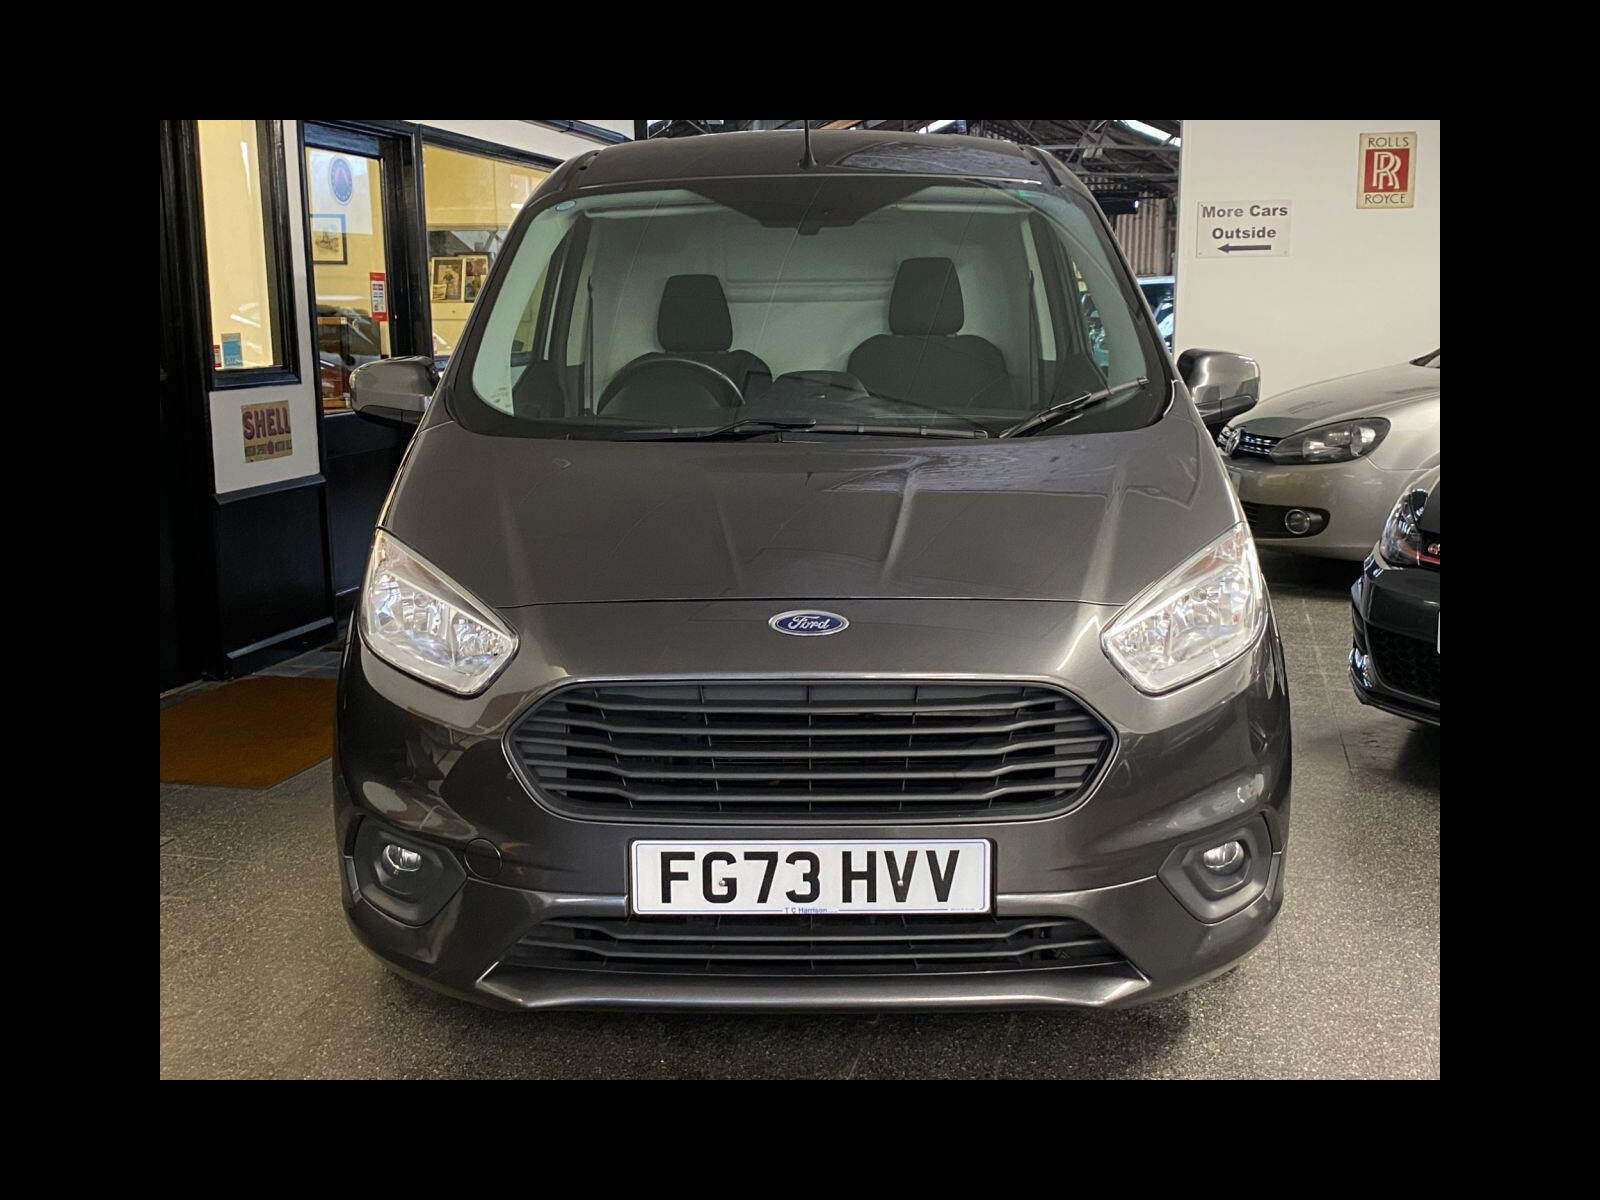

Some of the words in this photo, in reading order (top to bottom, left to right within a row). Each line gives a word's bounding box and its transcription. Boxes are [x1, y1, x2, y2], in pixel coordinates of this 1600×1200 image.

[1368, 137, 1409, 148] ROLLS
[1364, 193, 1407, 204] ROYCE
[1202, 206, 1244, 218] More
[1249, 205, 1288, 217] Cars
[1212, 227, 1277, 239] Outside
[242, 407, 291, 440] SHELL
[788, 616, 831, 629] Ford
[660, 851, 821, 904] FG73
[842, 850, 960, 903] HVV
